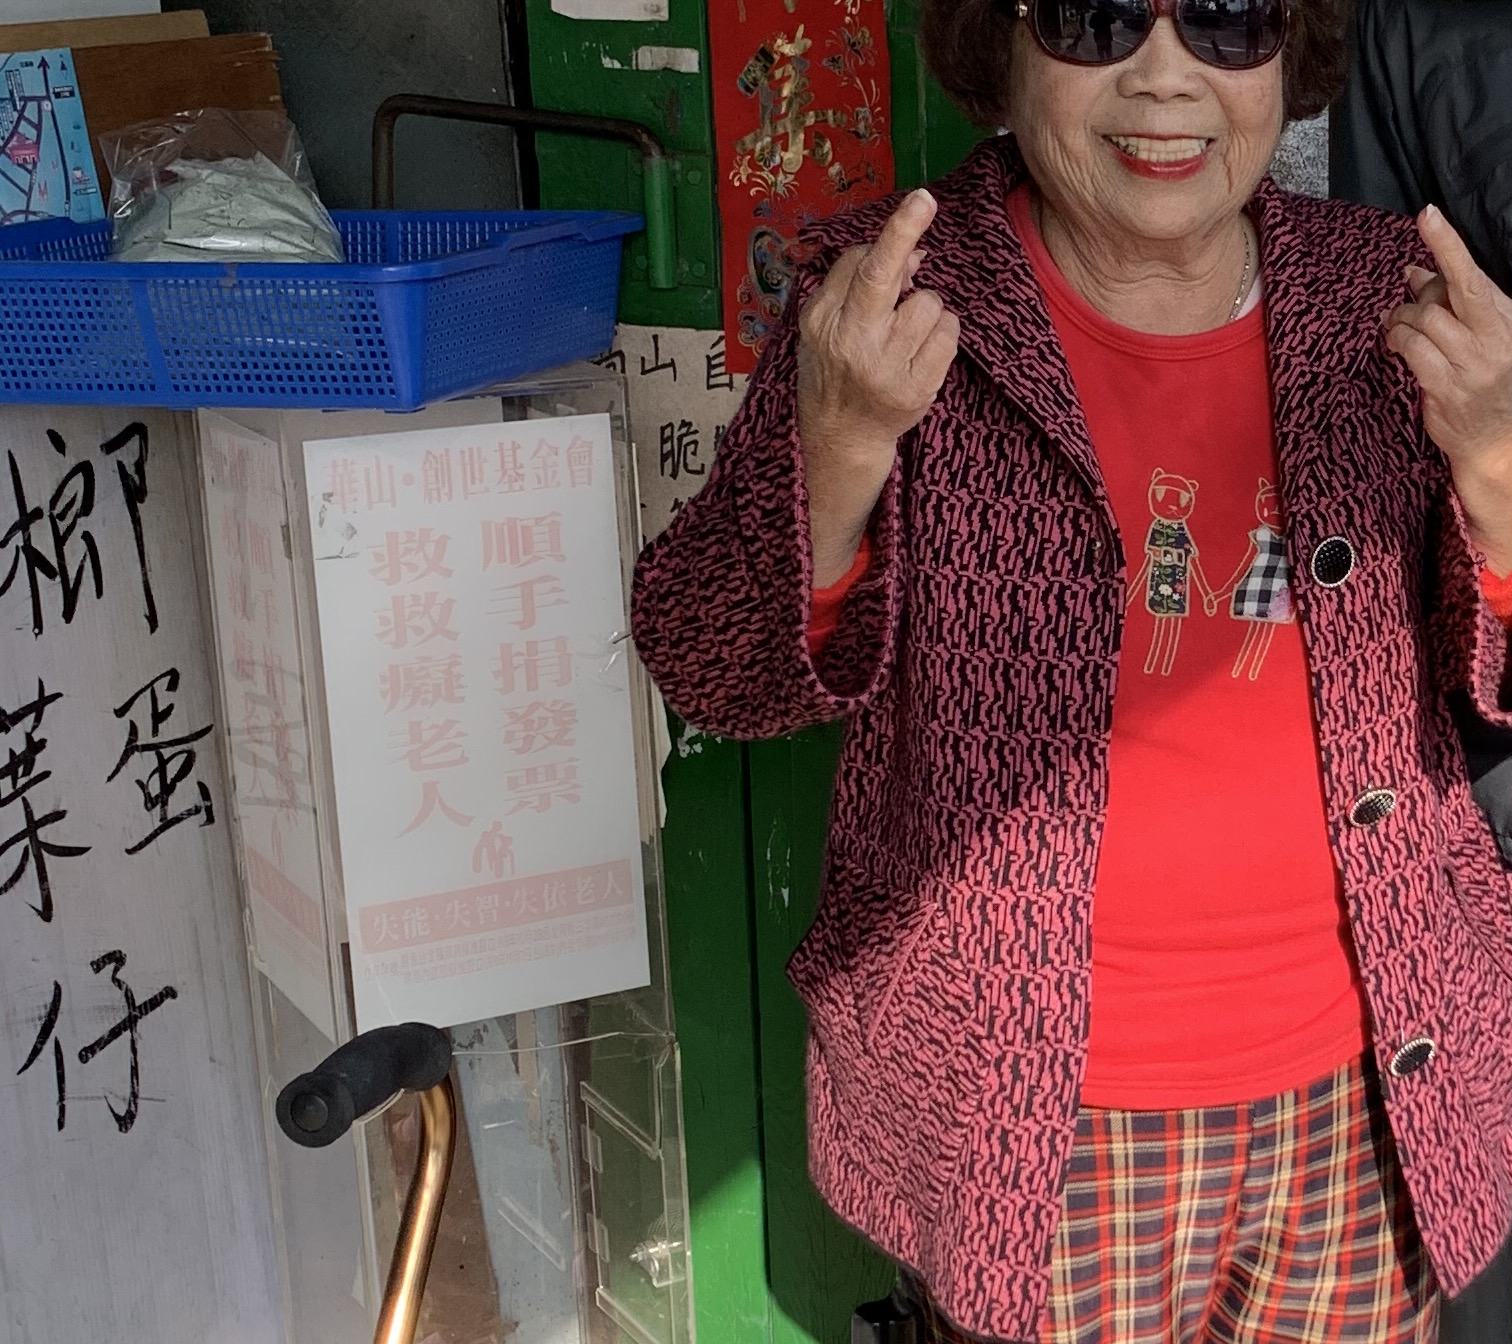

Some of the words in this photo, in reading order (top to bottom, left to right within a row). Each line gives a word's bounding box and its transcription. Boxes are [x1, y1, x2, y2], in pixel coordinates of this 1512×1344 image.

[368, 526, 476, 841] 救救癡老人
[480, 511, 583, 819] 順手捐發票
